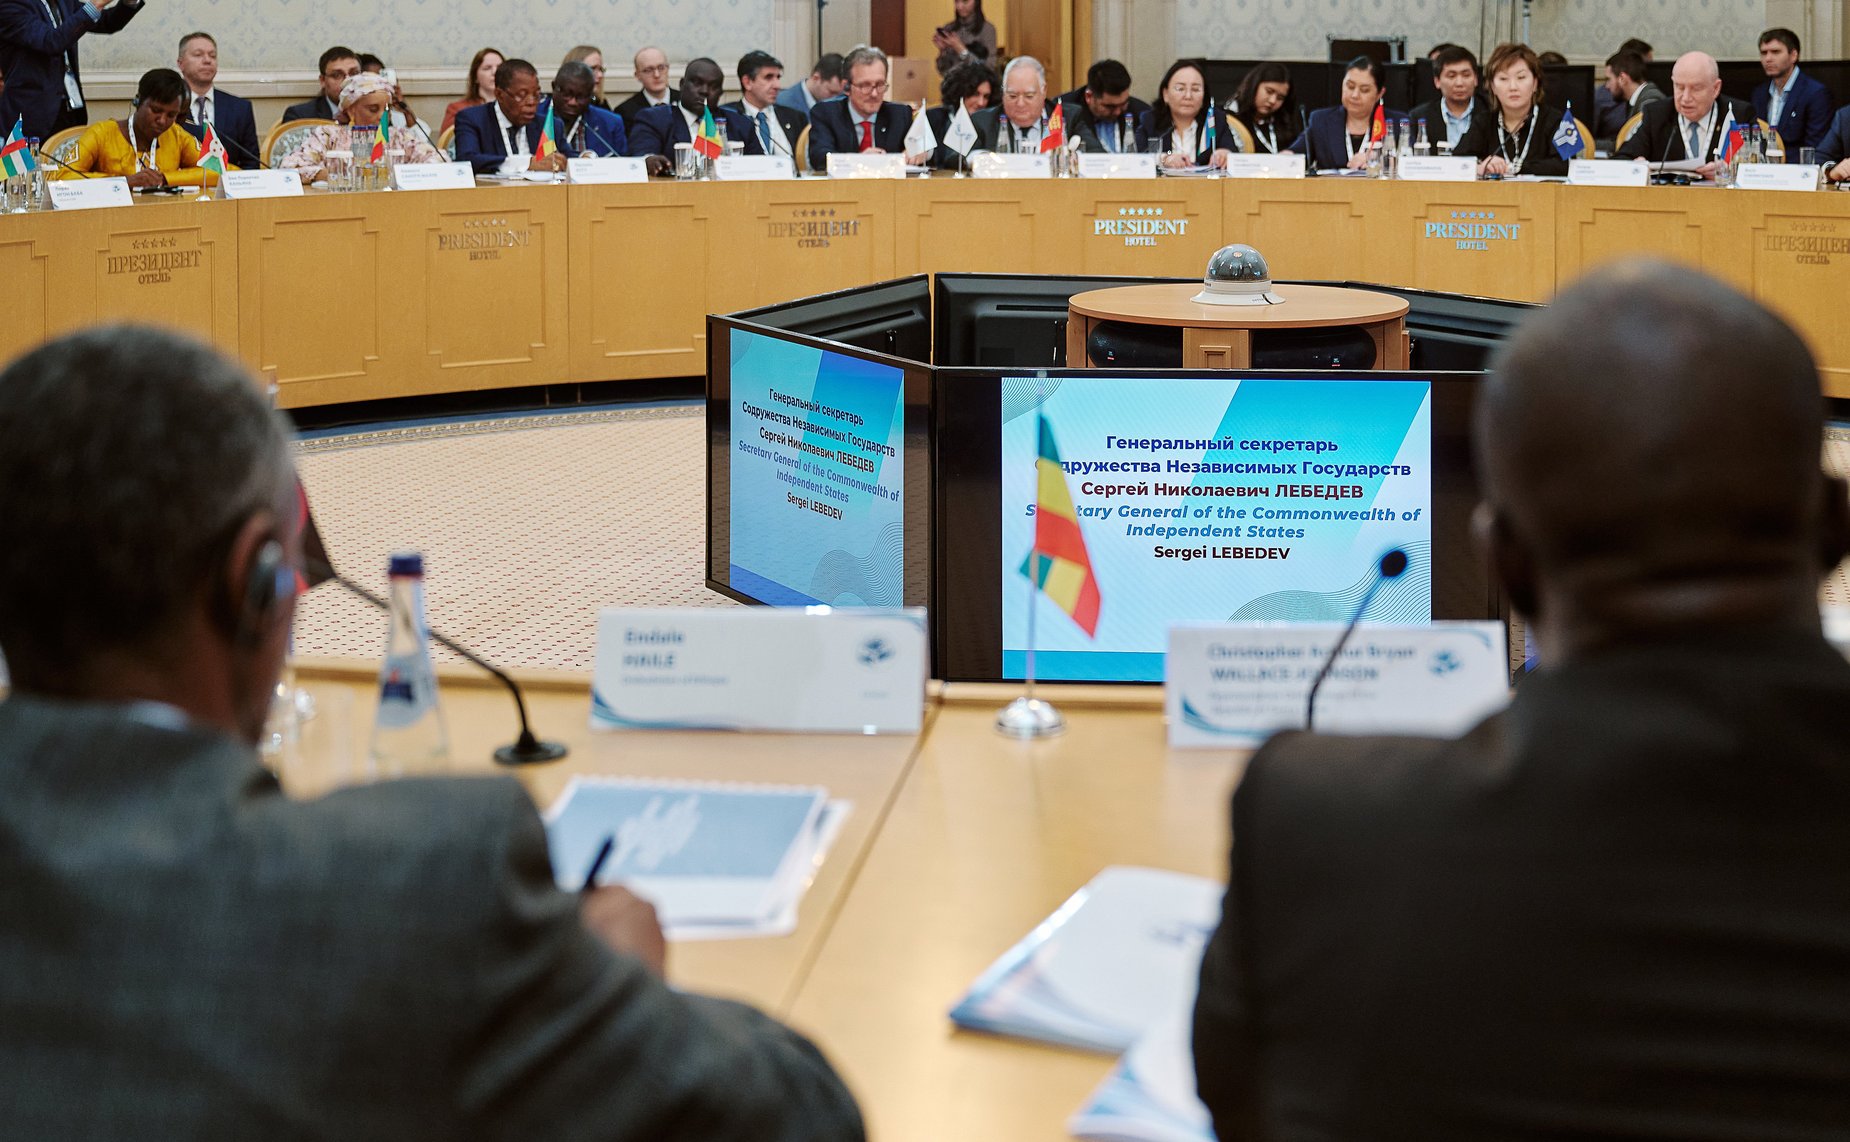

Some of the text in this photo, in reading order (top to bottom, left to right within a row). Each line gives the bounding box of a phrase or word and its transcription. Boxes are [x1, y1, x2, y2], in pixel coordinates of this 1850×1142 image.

[768, 220, 860, 239] ПРЕЗИДЕНТ
[1094, 219, 1188, 235] PRESIDENT
[1425, 222, 1520, 240] PRESIDENT
[438, 230, 531, 250] PRESIDENT
[797, 239, 830, 248] ОТЕЛЬ
[1125, 236, 1157, 246] HOTEL
[1456, 240, 1488, 250] HOTEL
[1763, 235, 1850, 255] ПРЕЗИДЕН
[107, 249, 202, 274] ПРЕЗИДЕНТ
[469, 250, 501, 260] HOTEL
[1796, 254, 1830, 265] ОТЕЛЬ
[138, 272, 171, 284] ОТЕЛЬ
[769, 388, 864, 427] Генеральный секретарь
[742, 401, 895, 457] Содружества Независимых Государств
[759, 427, 874, 473] Сергей Николаевич ЛЕБЕДЕВ
[1106, 435, 1339, 454] Генеральный секретарь
[738, 440, 900, 502] Secretary General of the Commonwealth of
[1035, 458, 1411, 478] дружества Независимых Государств
[776, 468, 849, 503] Independent States
[1081, 481, 1363, 500] Сергей Николаевич ЛЕБЕДЕВ
[787, 491, 843, 520] Sergei LEBEDEV
[1025, 503, 1421, 522] Stary General of the Commonwealth of
[1126, 523, 1305, 539] Independent States
[1154, 545, 1290, 561] Sergei LEBEDEV
